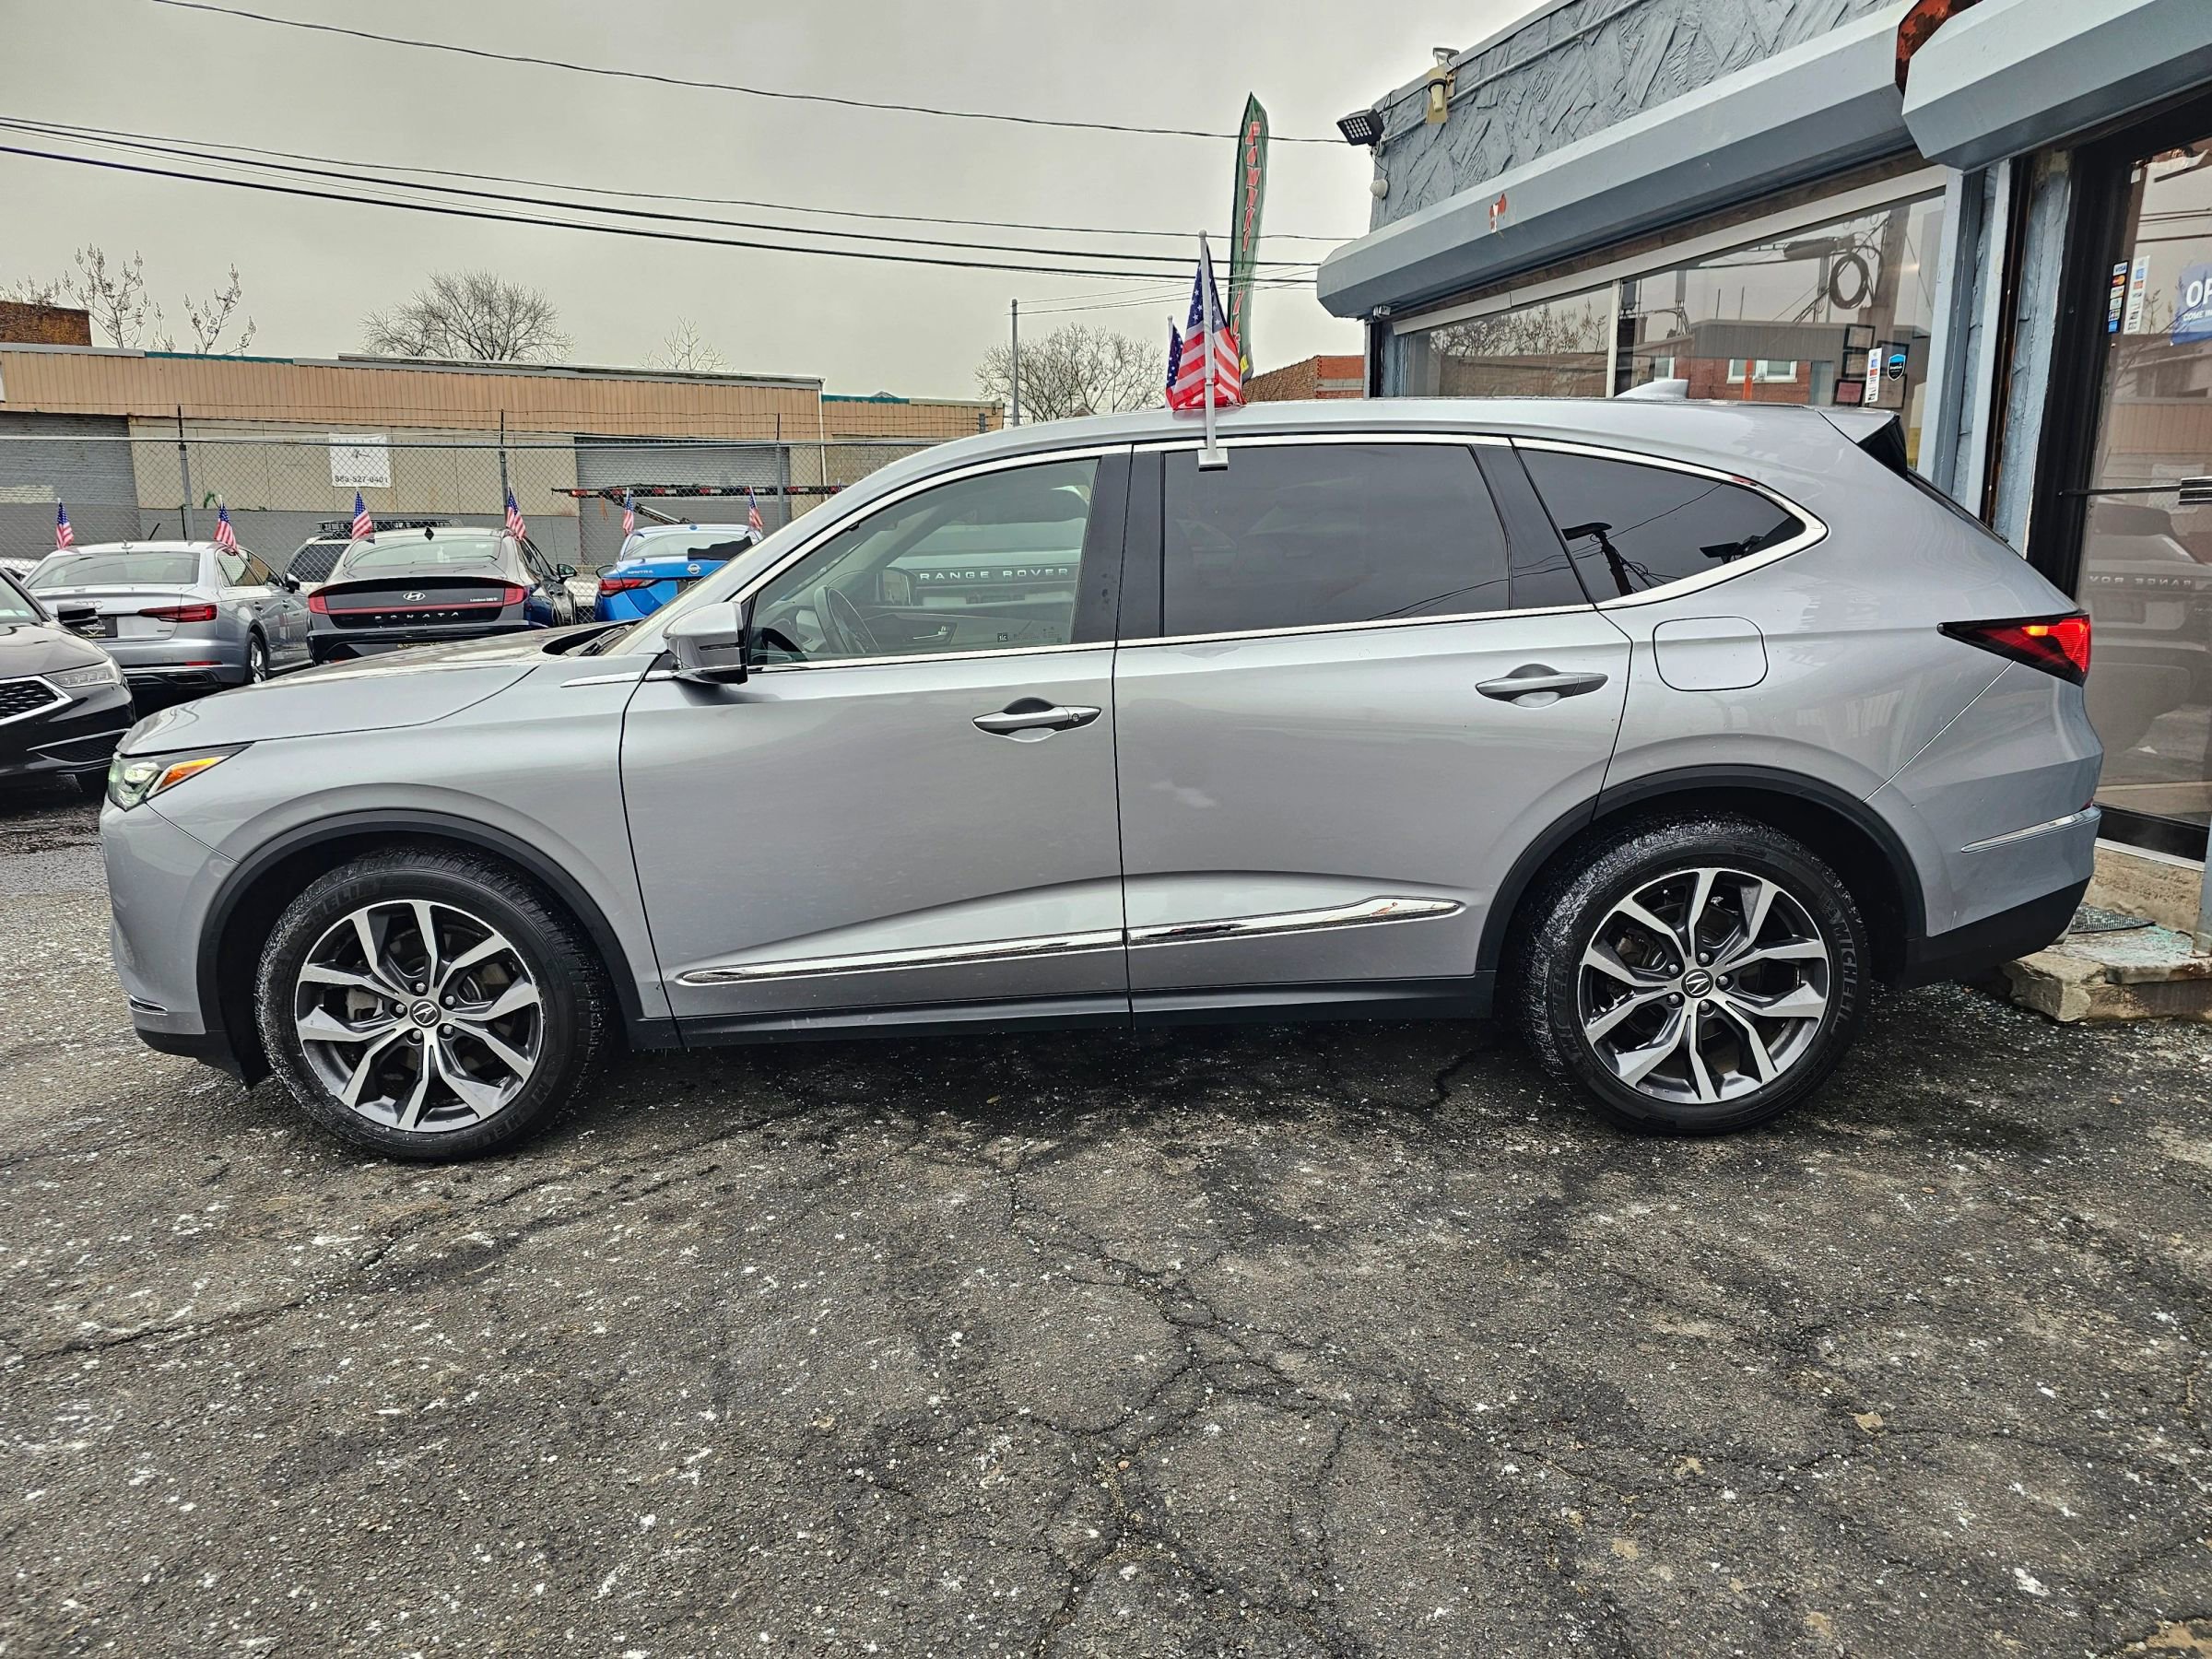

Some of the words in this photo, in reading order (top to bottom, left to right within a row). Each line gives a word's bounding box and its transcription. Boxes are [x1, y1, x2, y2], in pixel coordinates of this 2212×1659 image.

[2183, 311, 2205, 322] COME
[919, 571, 991, 581] RANGE
[1002, 568, 1069, 578] ROVER
